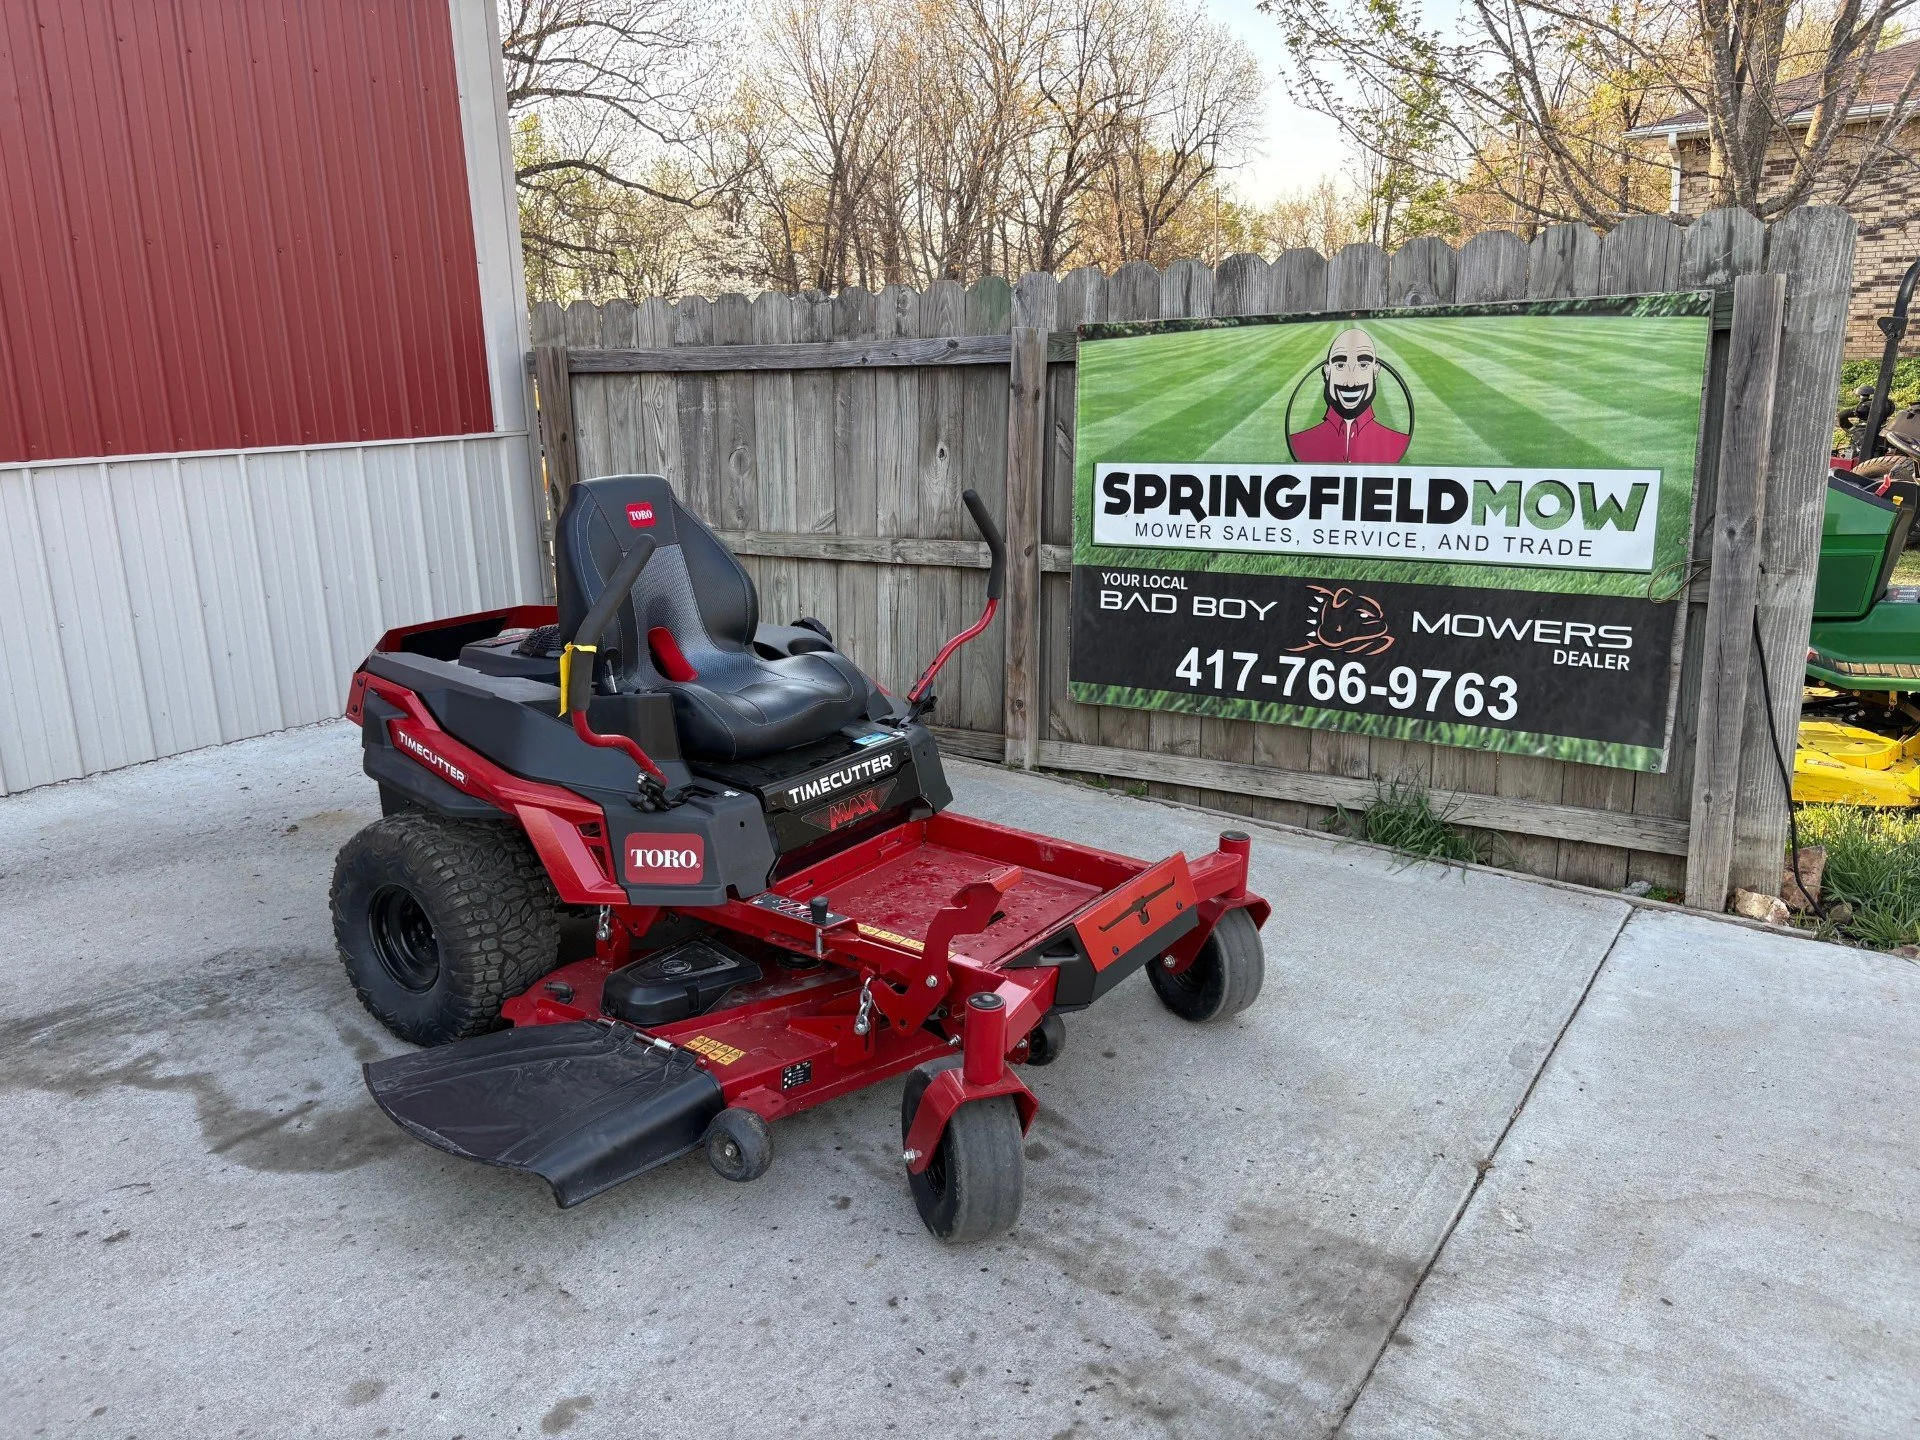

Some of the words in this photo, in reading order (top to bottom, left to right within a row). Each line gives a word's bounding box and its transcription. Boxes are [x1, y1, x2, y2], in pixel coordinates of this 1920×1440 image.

[628, 509, 653, 521] TORO
[1135, 522, 1212, 540] MOWER
[1222, 524, 1300, 546] SALES,
[1312, 528, 1426, 552] SERVICE,
[1437, 533, 1490, 552] AND
[1503, 536, 1593, 557] TRADE
[1101, 572, 1140, 588] YOUR
[1142, 574, 1189, 590] LOCAL
[1099, 590, 1178, 614] BAD
[1192, 595, 1279, 621] BOY
[1411, 610, 1634, 650] MOWERS
[1552, 649, 1631, 672] DEALER
[1174, 646, 1518, 721] 417-766-9763
[398, 730, 466, 785] TIMECUTTER
[787, 753, 893, 805] TIMECUTTER
[829, 788, 879, 831] MAX
